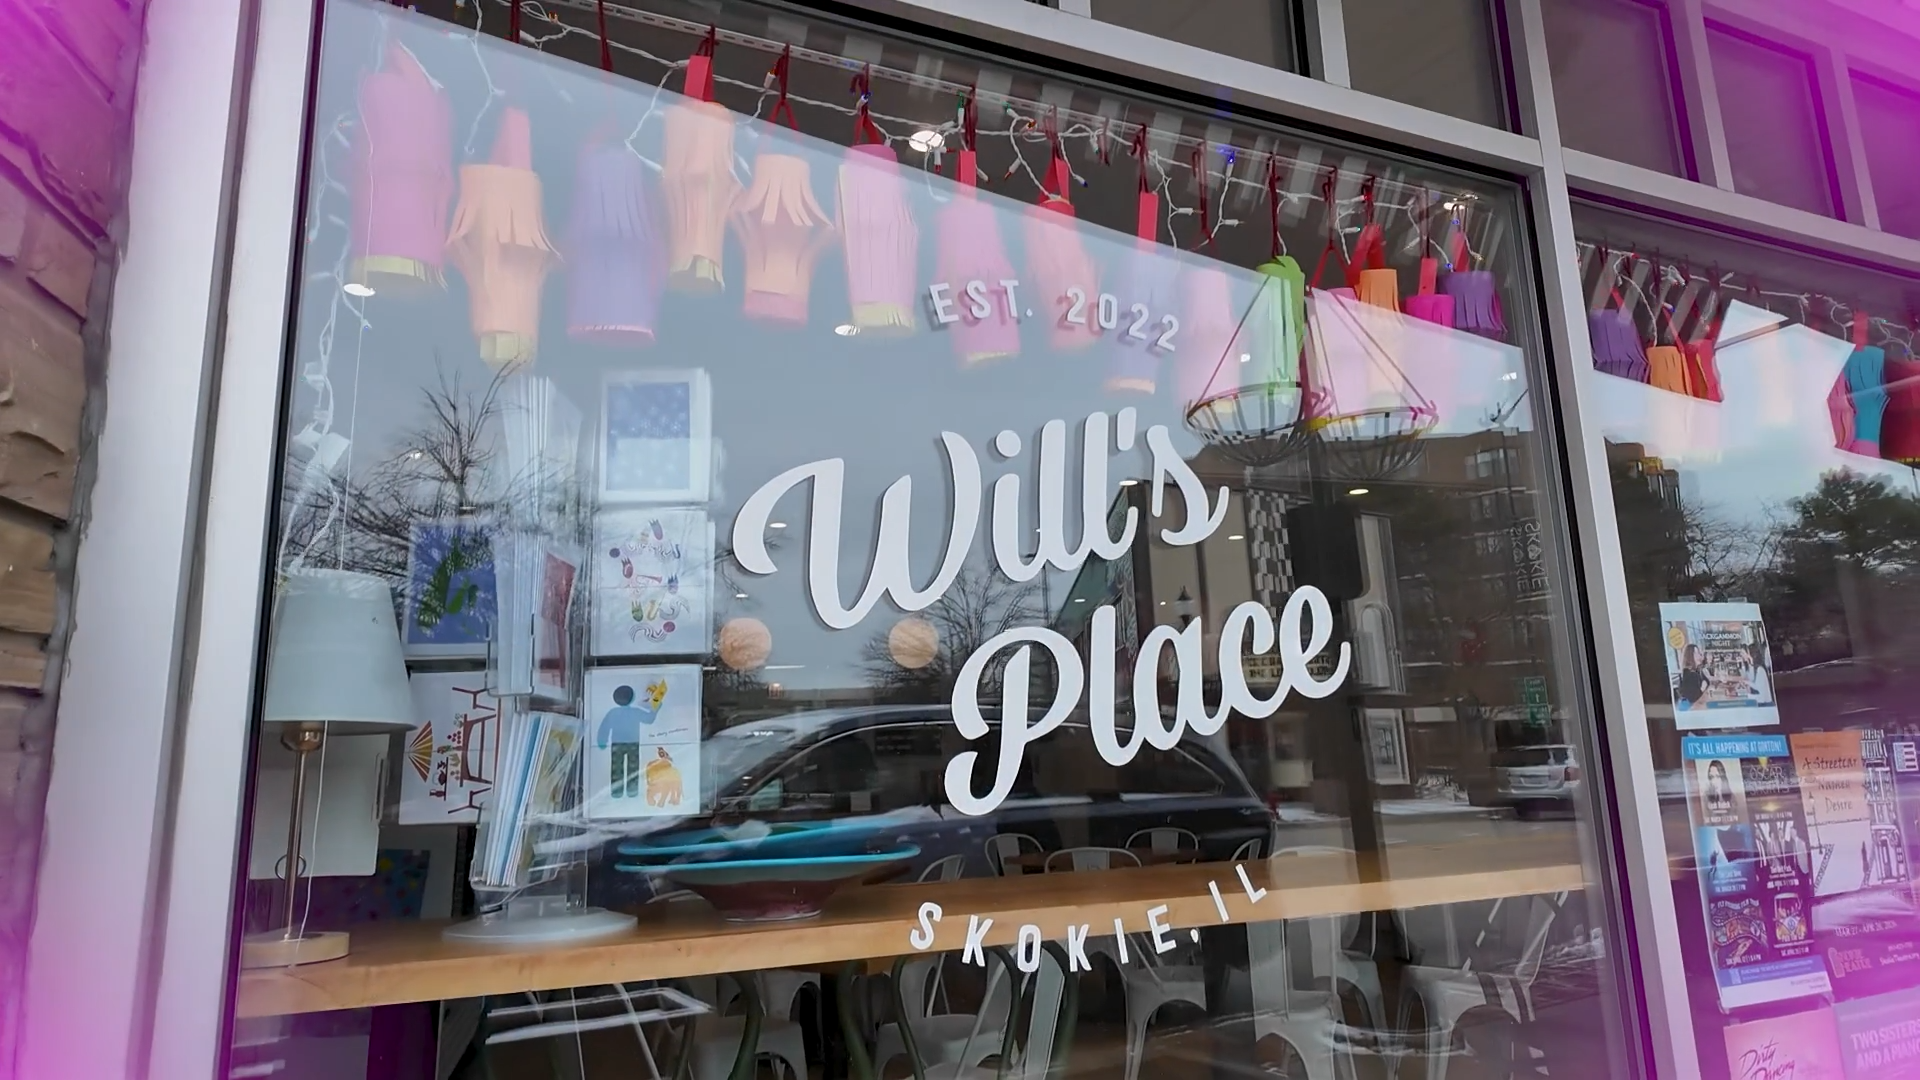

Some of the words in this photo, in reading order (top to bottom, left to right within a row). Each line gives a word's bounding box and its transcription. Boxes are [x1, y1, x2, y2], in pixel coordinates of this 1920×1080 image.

[928, 279, 1033, 323] EST.
[1065, 287, 1181, 351] 2022
[732, 406, 1230, 630] Will's
[943, 584, 1352, 816] Place
[1688, 743, 1701, 755] IT'S
[1702, 742, 1715, 754] ALL
[1715, 741, 1749, 754] HAPPENING
[1750, 741, 1757, 753] AT
[1813, 757, 1857, 769] Streetcar
[909, 901, 1200, 973] SKOKIE,
[1208, 863, 1267, 923] IL
[1739, 1037, 1779, 1077] Dirty
[1851, 1030, 1879, 1050] TWO
[1857, 1050, 1882, 1070] AND
